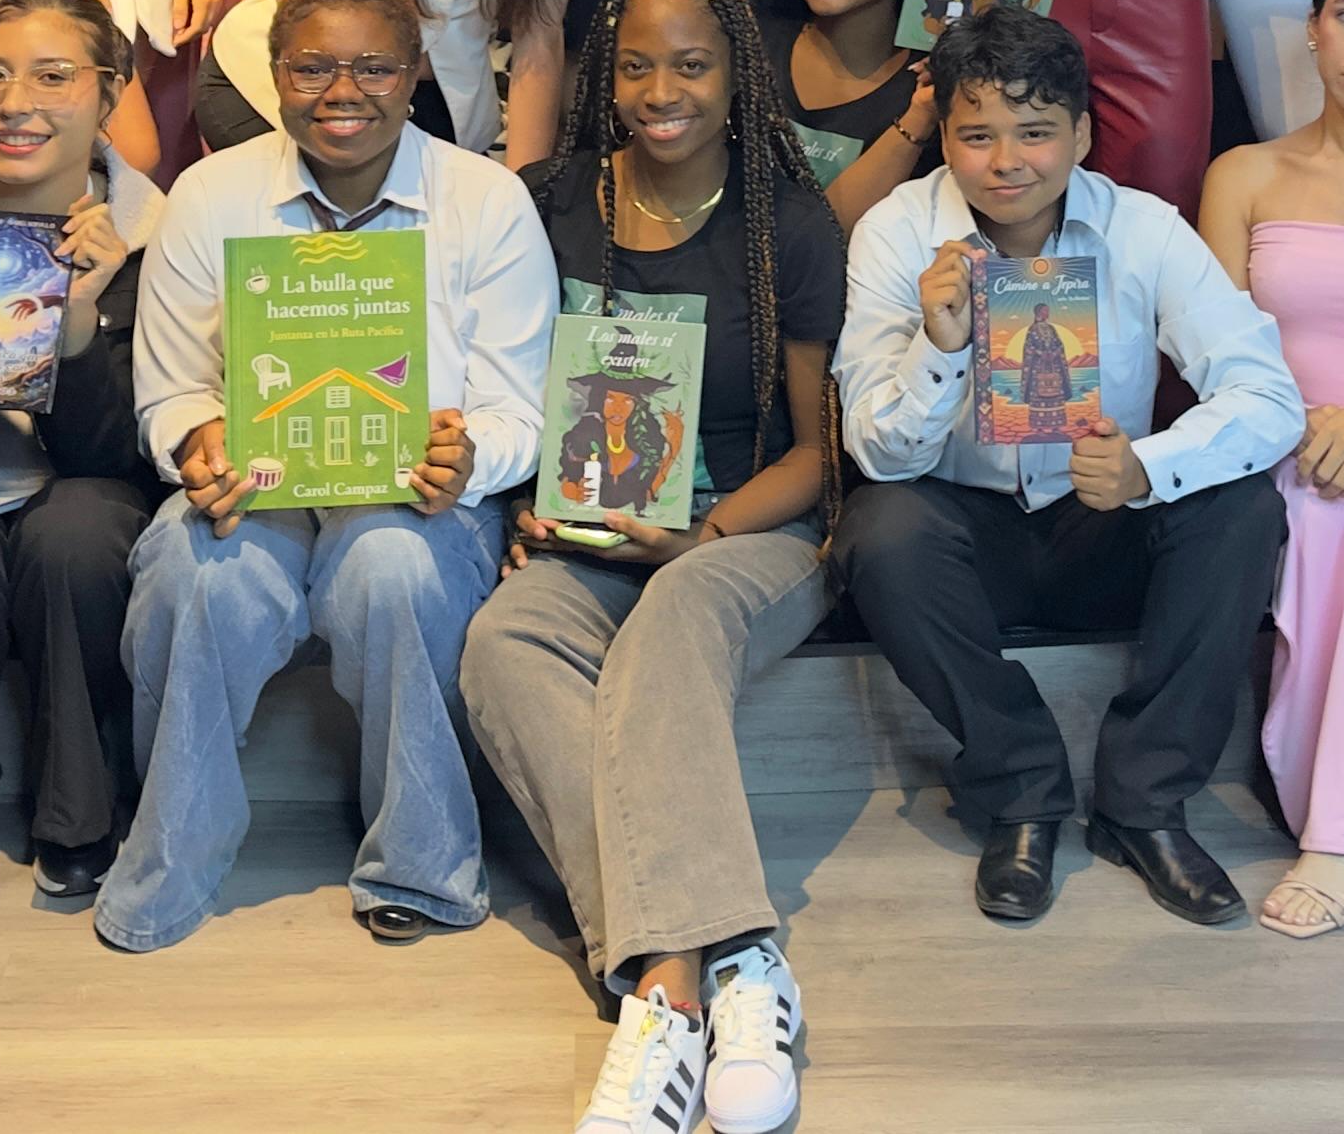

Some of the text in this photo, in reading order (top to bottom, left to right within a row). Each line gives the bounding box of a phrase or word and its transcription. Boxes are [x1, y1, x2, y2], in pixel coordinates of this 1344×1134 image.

[281, 273, 395, 296] La bulla que
[266, 297, 411, 320] hacemos juntas
[315, 331, 328, 340] en
[329, 328, 340, 339] la
[341, 328, 365, 339] Ruta
[586, 325, 615, 344] Los
[617, 330, 658, 347] males
[600, 352, 651, 370] existen
[292, 481, 389, 499] Carol Campaz
